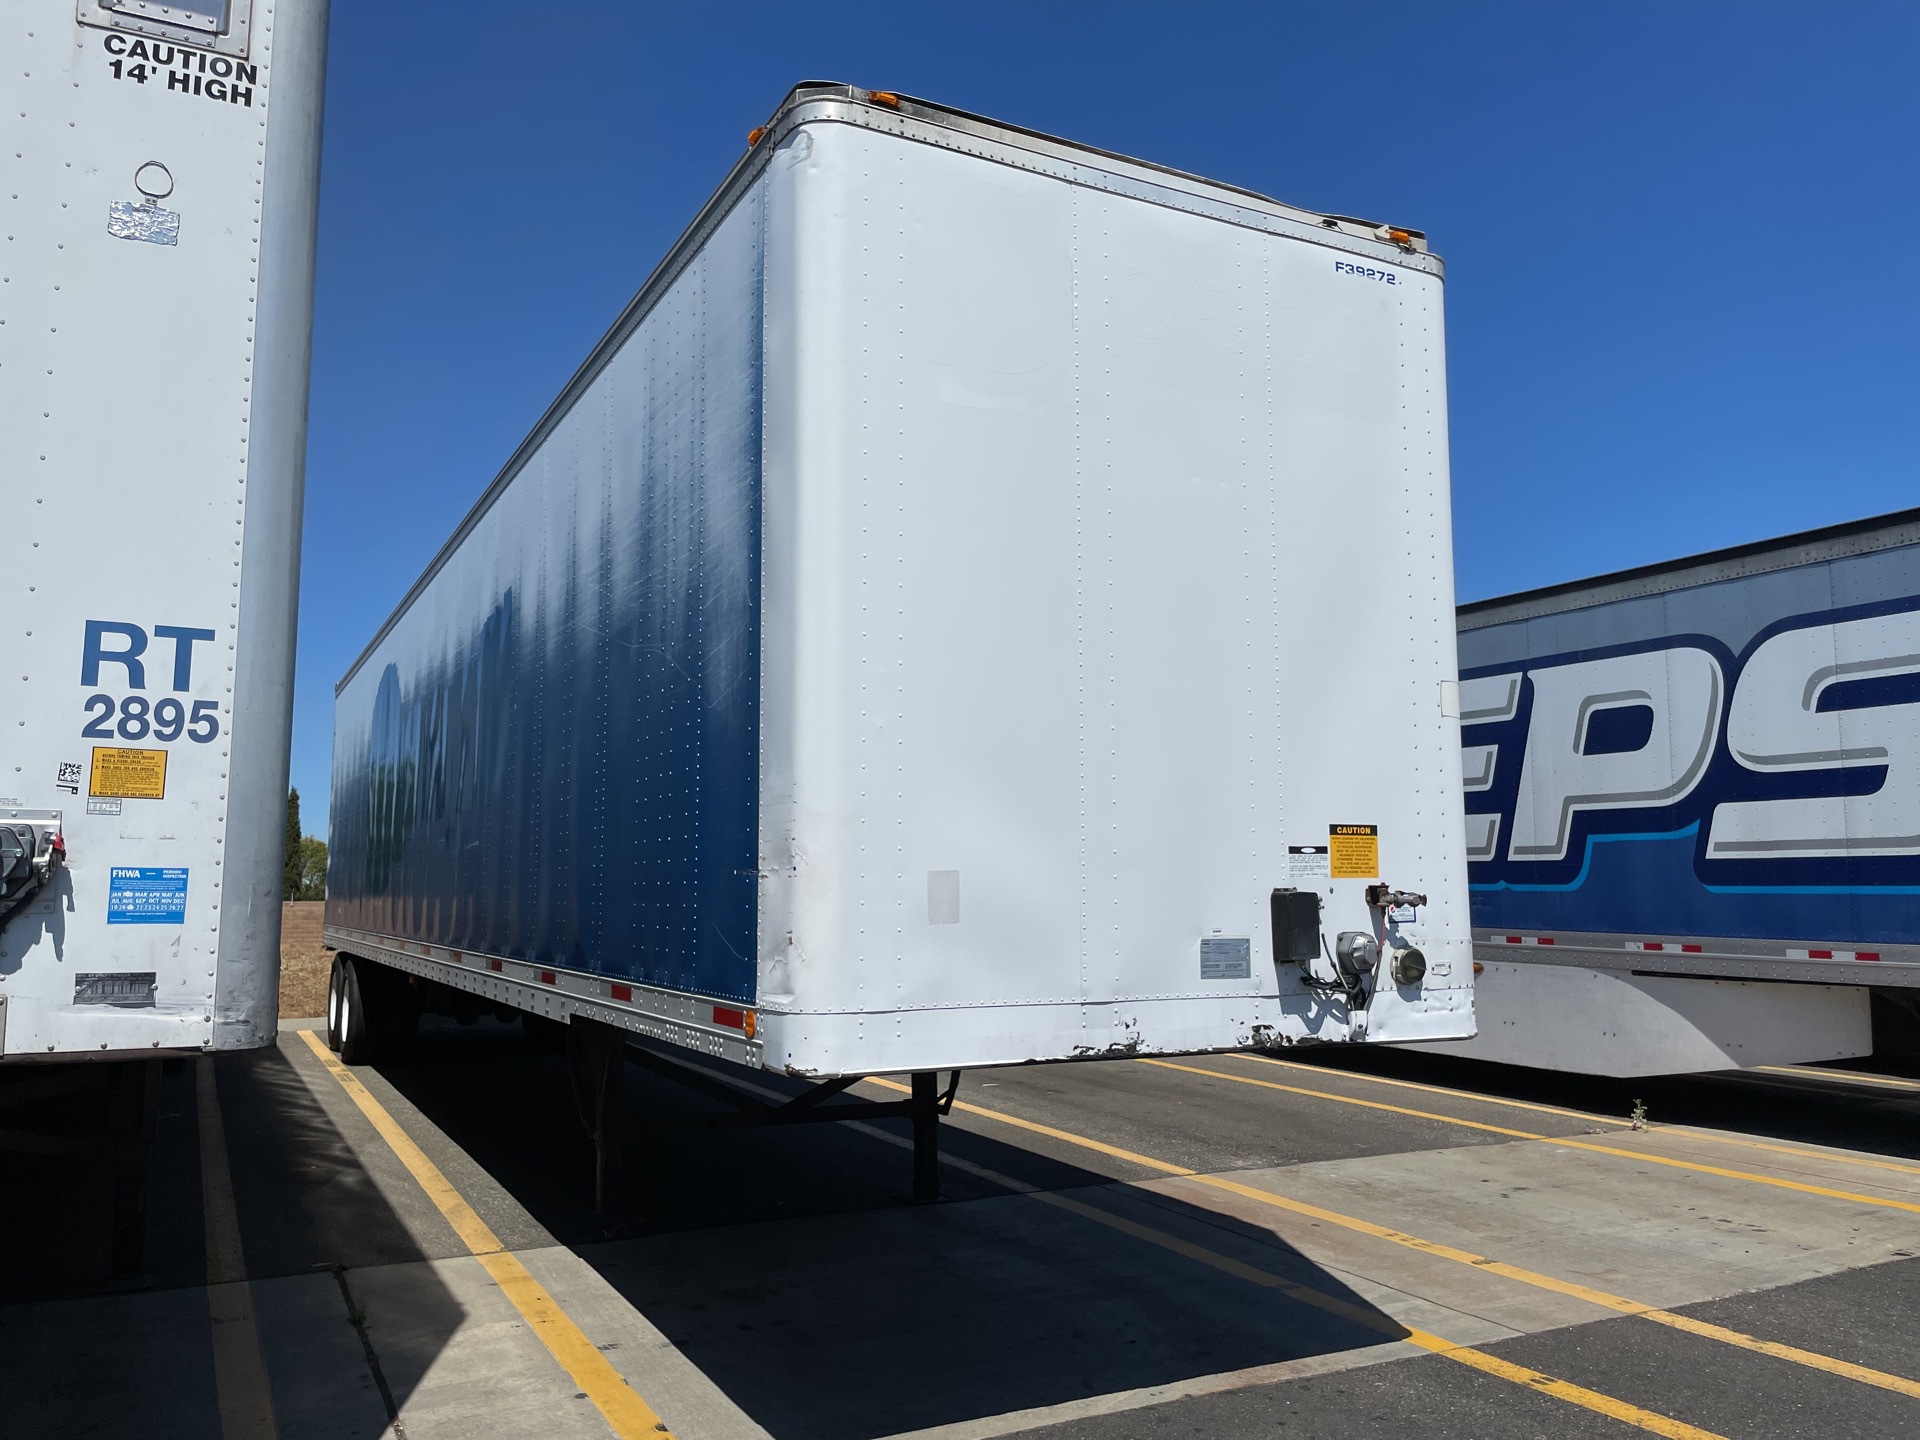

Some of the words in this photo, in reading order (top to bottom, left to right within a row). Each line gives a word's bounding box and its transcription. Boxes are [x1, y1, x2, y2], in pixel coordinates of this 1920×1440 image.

[103, 34, 258, 85] CAUTION
[109, 59, 157, 84] 14'
[167, 70, 253, 108] HIGH
[1335, 261, 1396, 285] F39272
[81, 620, 215, 692] RT
[81, 694, 219, 743] 2895
[1336, 826, 1371, 834] CAUTION
[112, 870, 141, 878] FHWA
